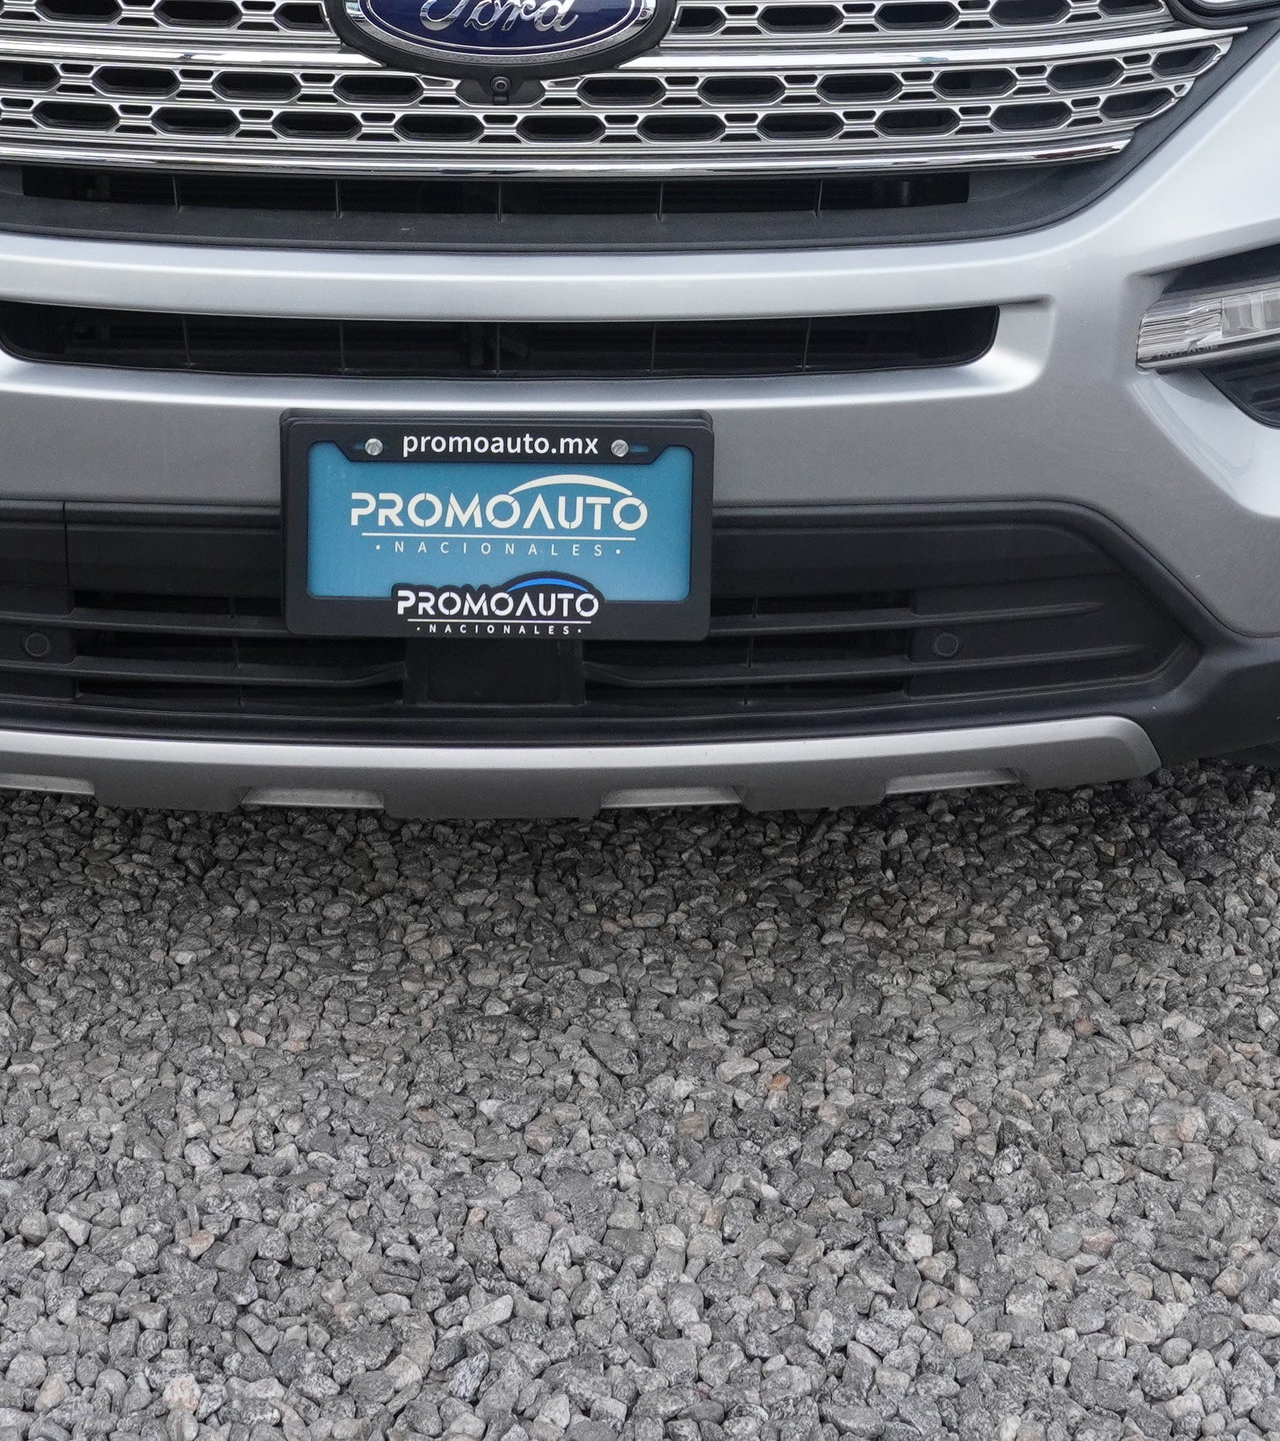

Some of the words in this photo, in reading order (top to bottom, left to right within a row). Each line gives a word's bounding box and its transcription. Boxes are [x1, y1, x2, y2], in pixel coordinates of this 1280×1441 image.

[403, 434, 599, 458] promoauto.mx
[350, 491, 648, 532] PROMOAUTO
[394, 540, 603, 557] NACIONALES
[397, 589, 599, 618] PROMOAUTO
[420, 623, 570, 635] NACIONALES
